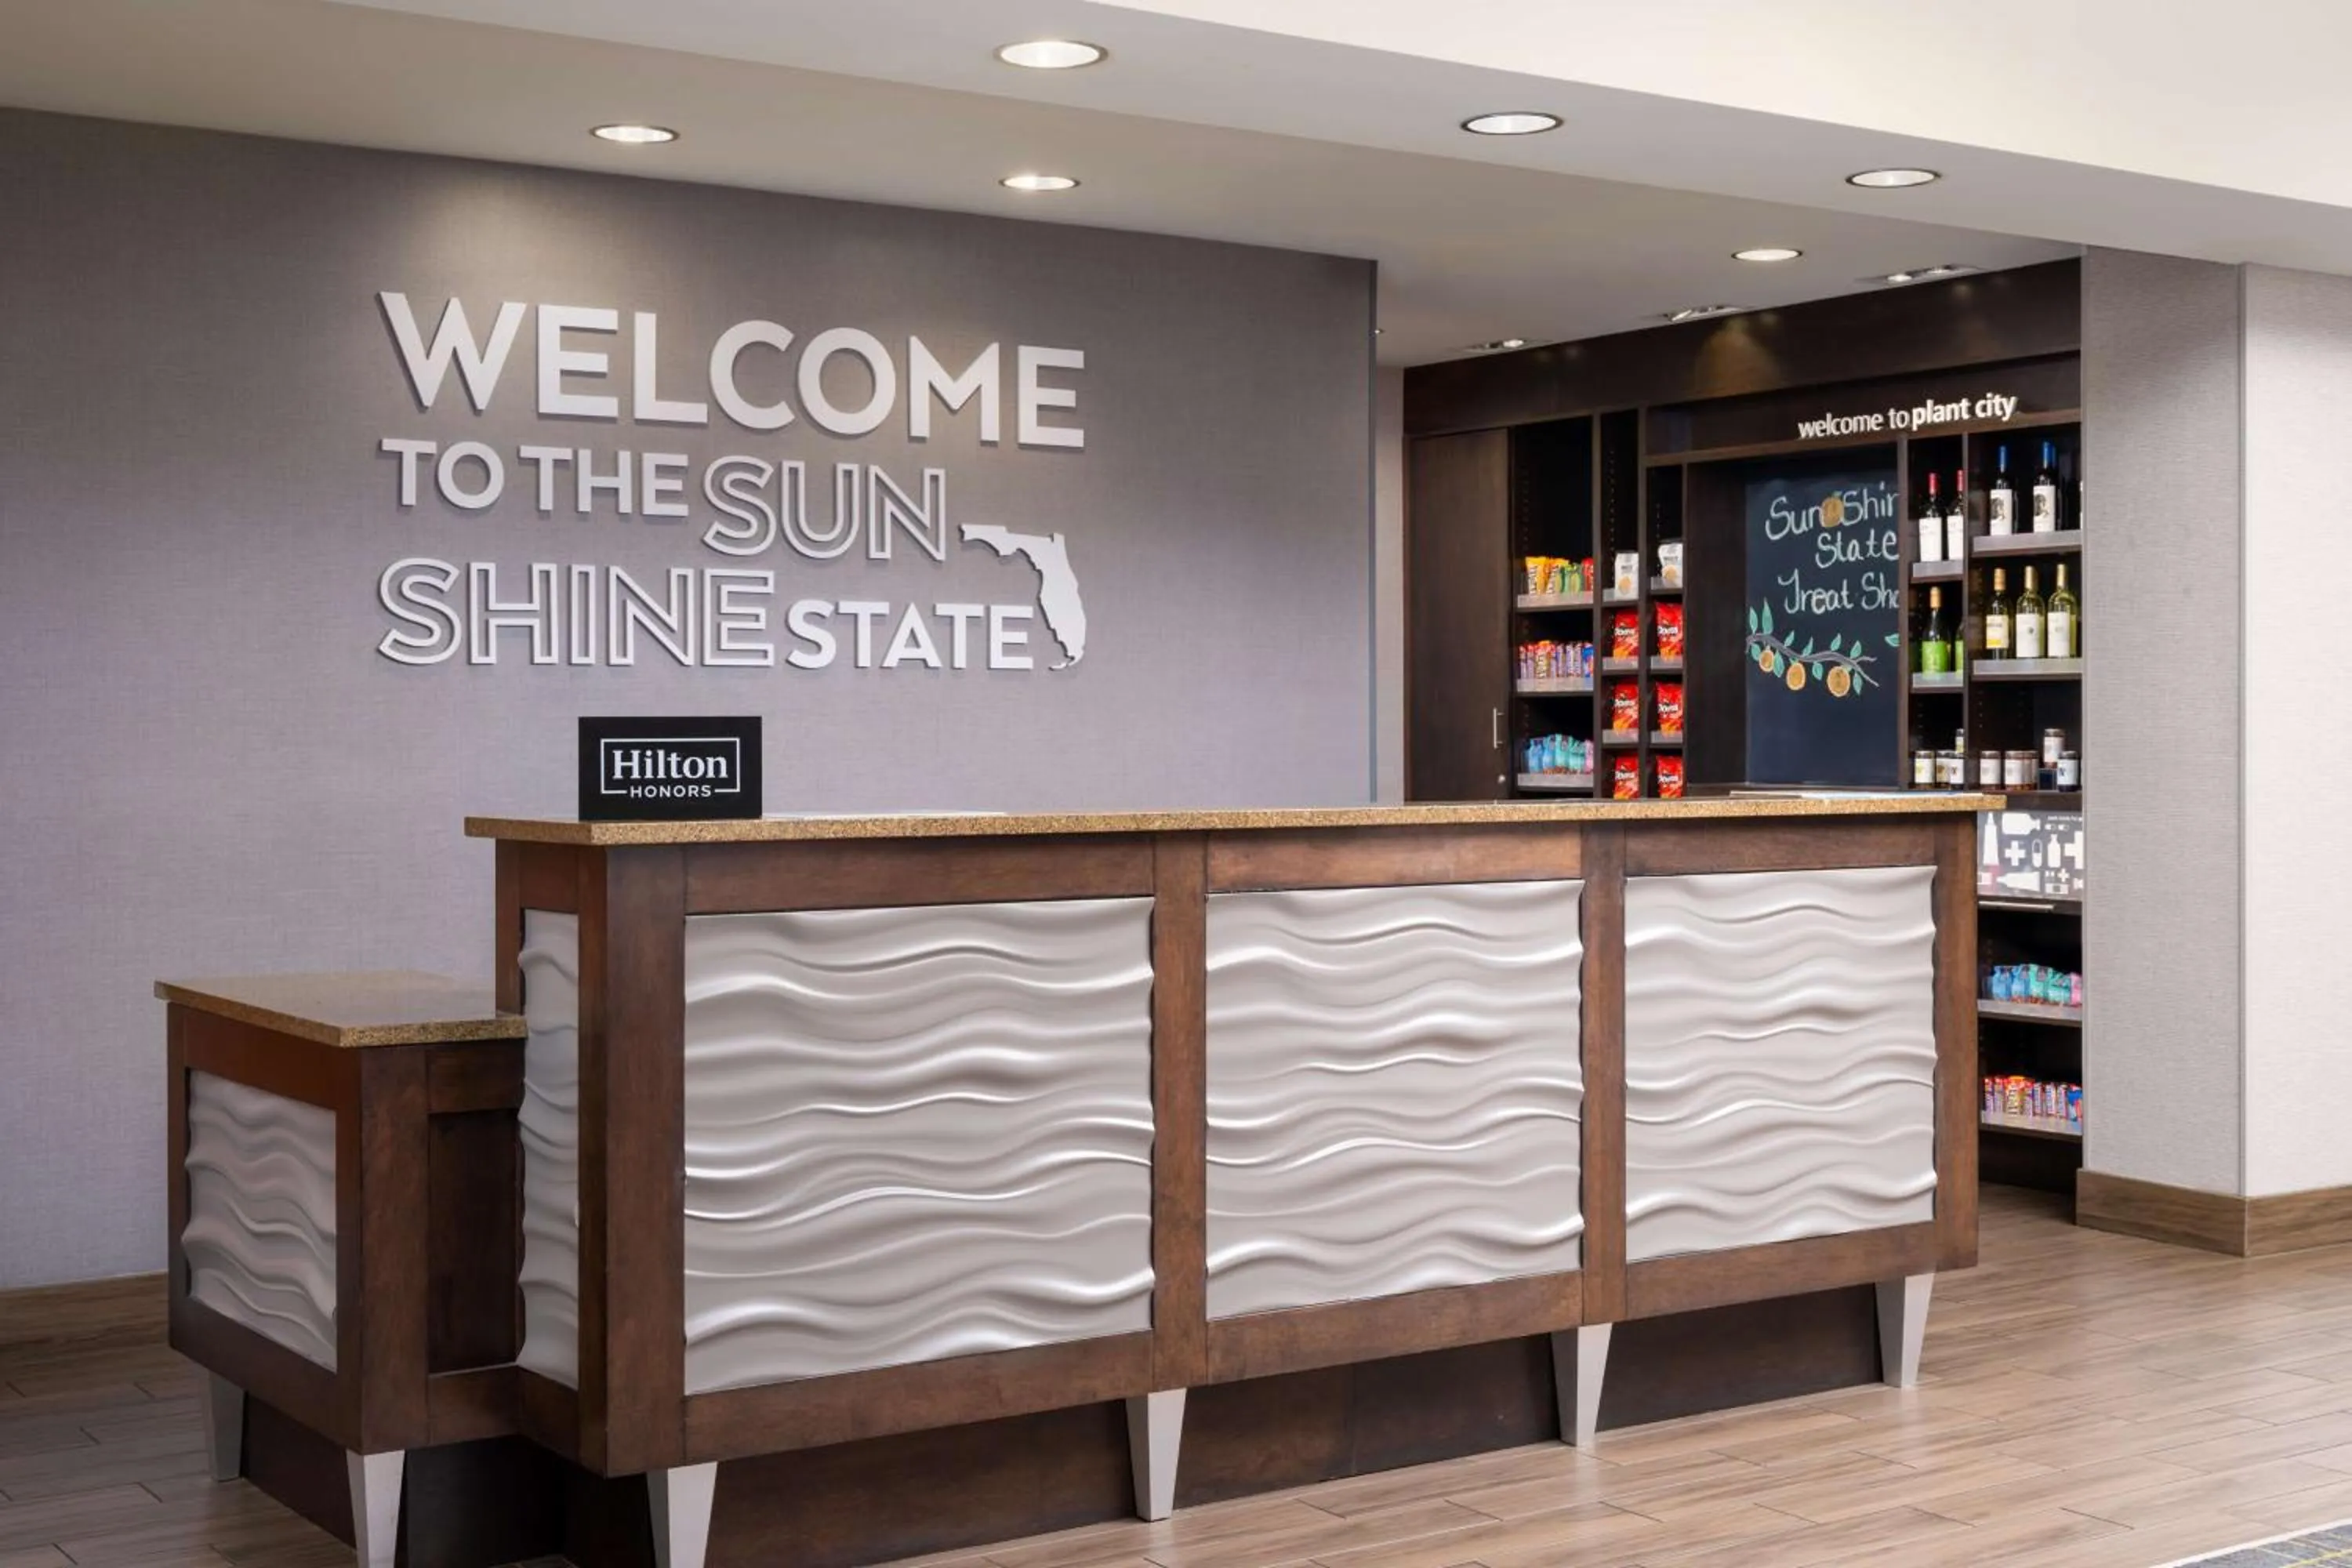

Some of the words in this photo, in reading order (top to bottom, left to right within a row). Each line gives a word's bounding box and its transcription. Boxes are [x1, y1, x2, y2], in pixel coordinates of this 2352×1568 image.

[379, 291, 1084, 448] WELCOME
[1798, 412, 1883, 439] welcome
[1888, 407, 1909, 429] to
[1912, 397, 1971, 431] plant
[1975, 392, 2017, 422] city
[381, 437, 505, 509] TO
[519, 445, 689, 517] THE
[702, 455, 946, 561] SUN
[1815, 528, 1900, 568] State
[377, 557, 775, 666] SHINE
[786, 599, 1033, 670] STATE
[1777, 568, 1854, 615] Treat
[612, 750, 728, 779] Hilton
[630, 785, 712, 798] HONORS
